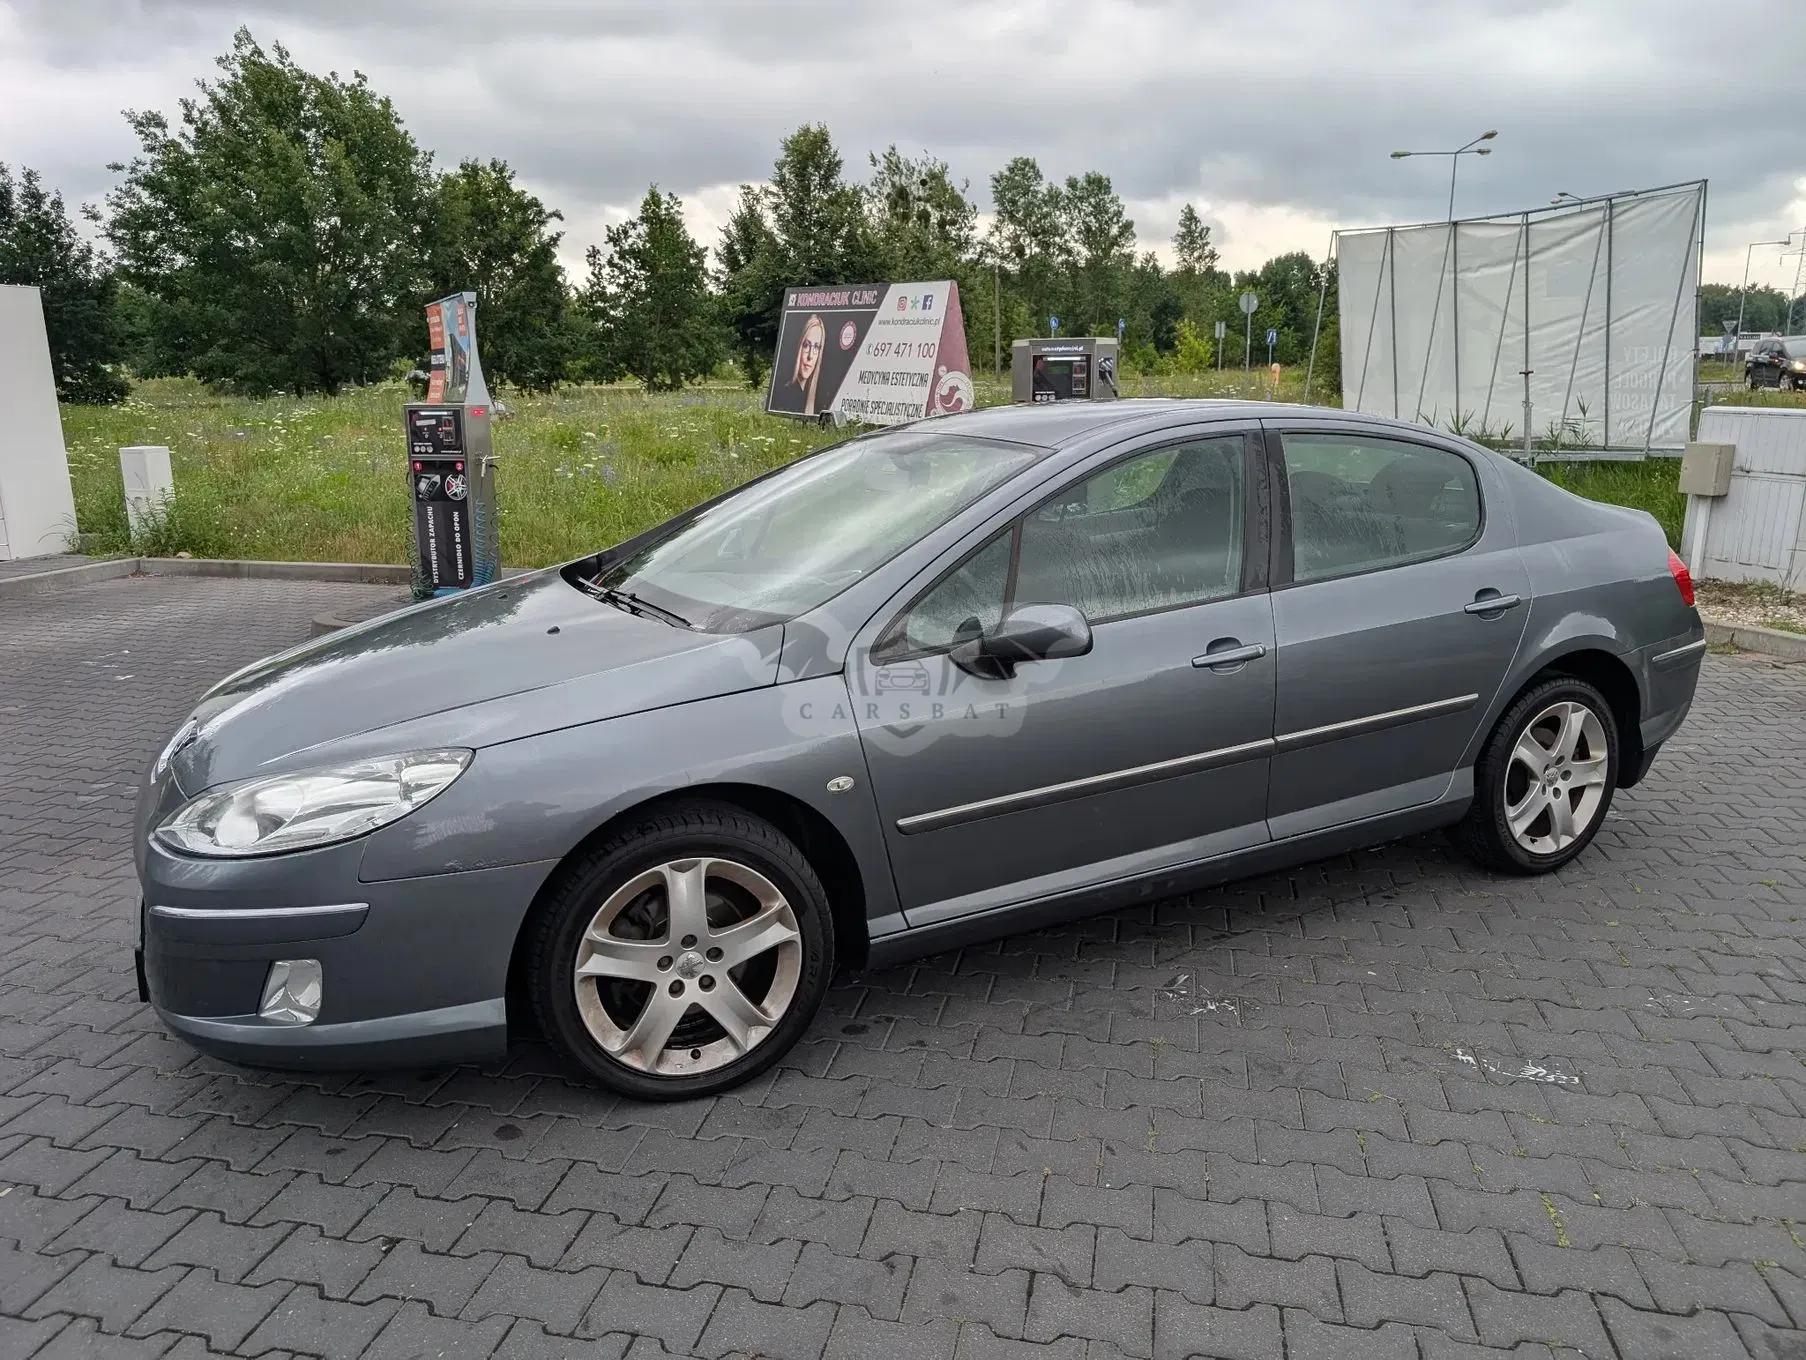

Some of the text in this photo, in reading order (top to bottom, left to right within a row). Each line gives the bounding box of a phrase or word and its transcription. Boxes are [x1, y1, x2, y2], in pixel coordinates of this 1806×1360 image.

[852, 290, 878, 306] CLINIC
[873, 342, 936, 359] 697 471 100
[857, 369, 929, 388] MEDYCYNA ESTETYCZNA
[870, 400, 924, 418] SPECJALISTYCZNE
[427, 506, 439, 584] DYSTRYBUTOR ZAPACHU
[455, 533, 461, 543] DO
